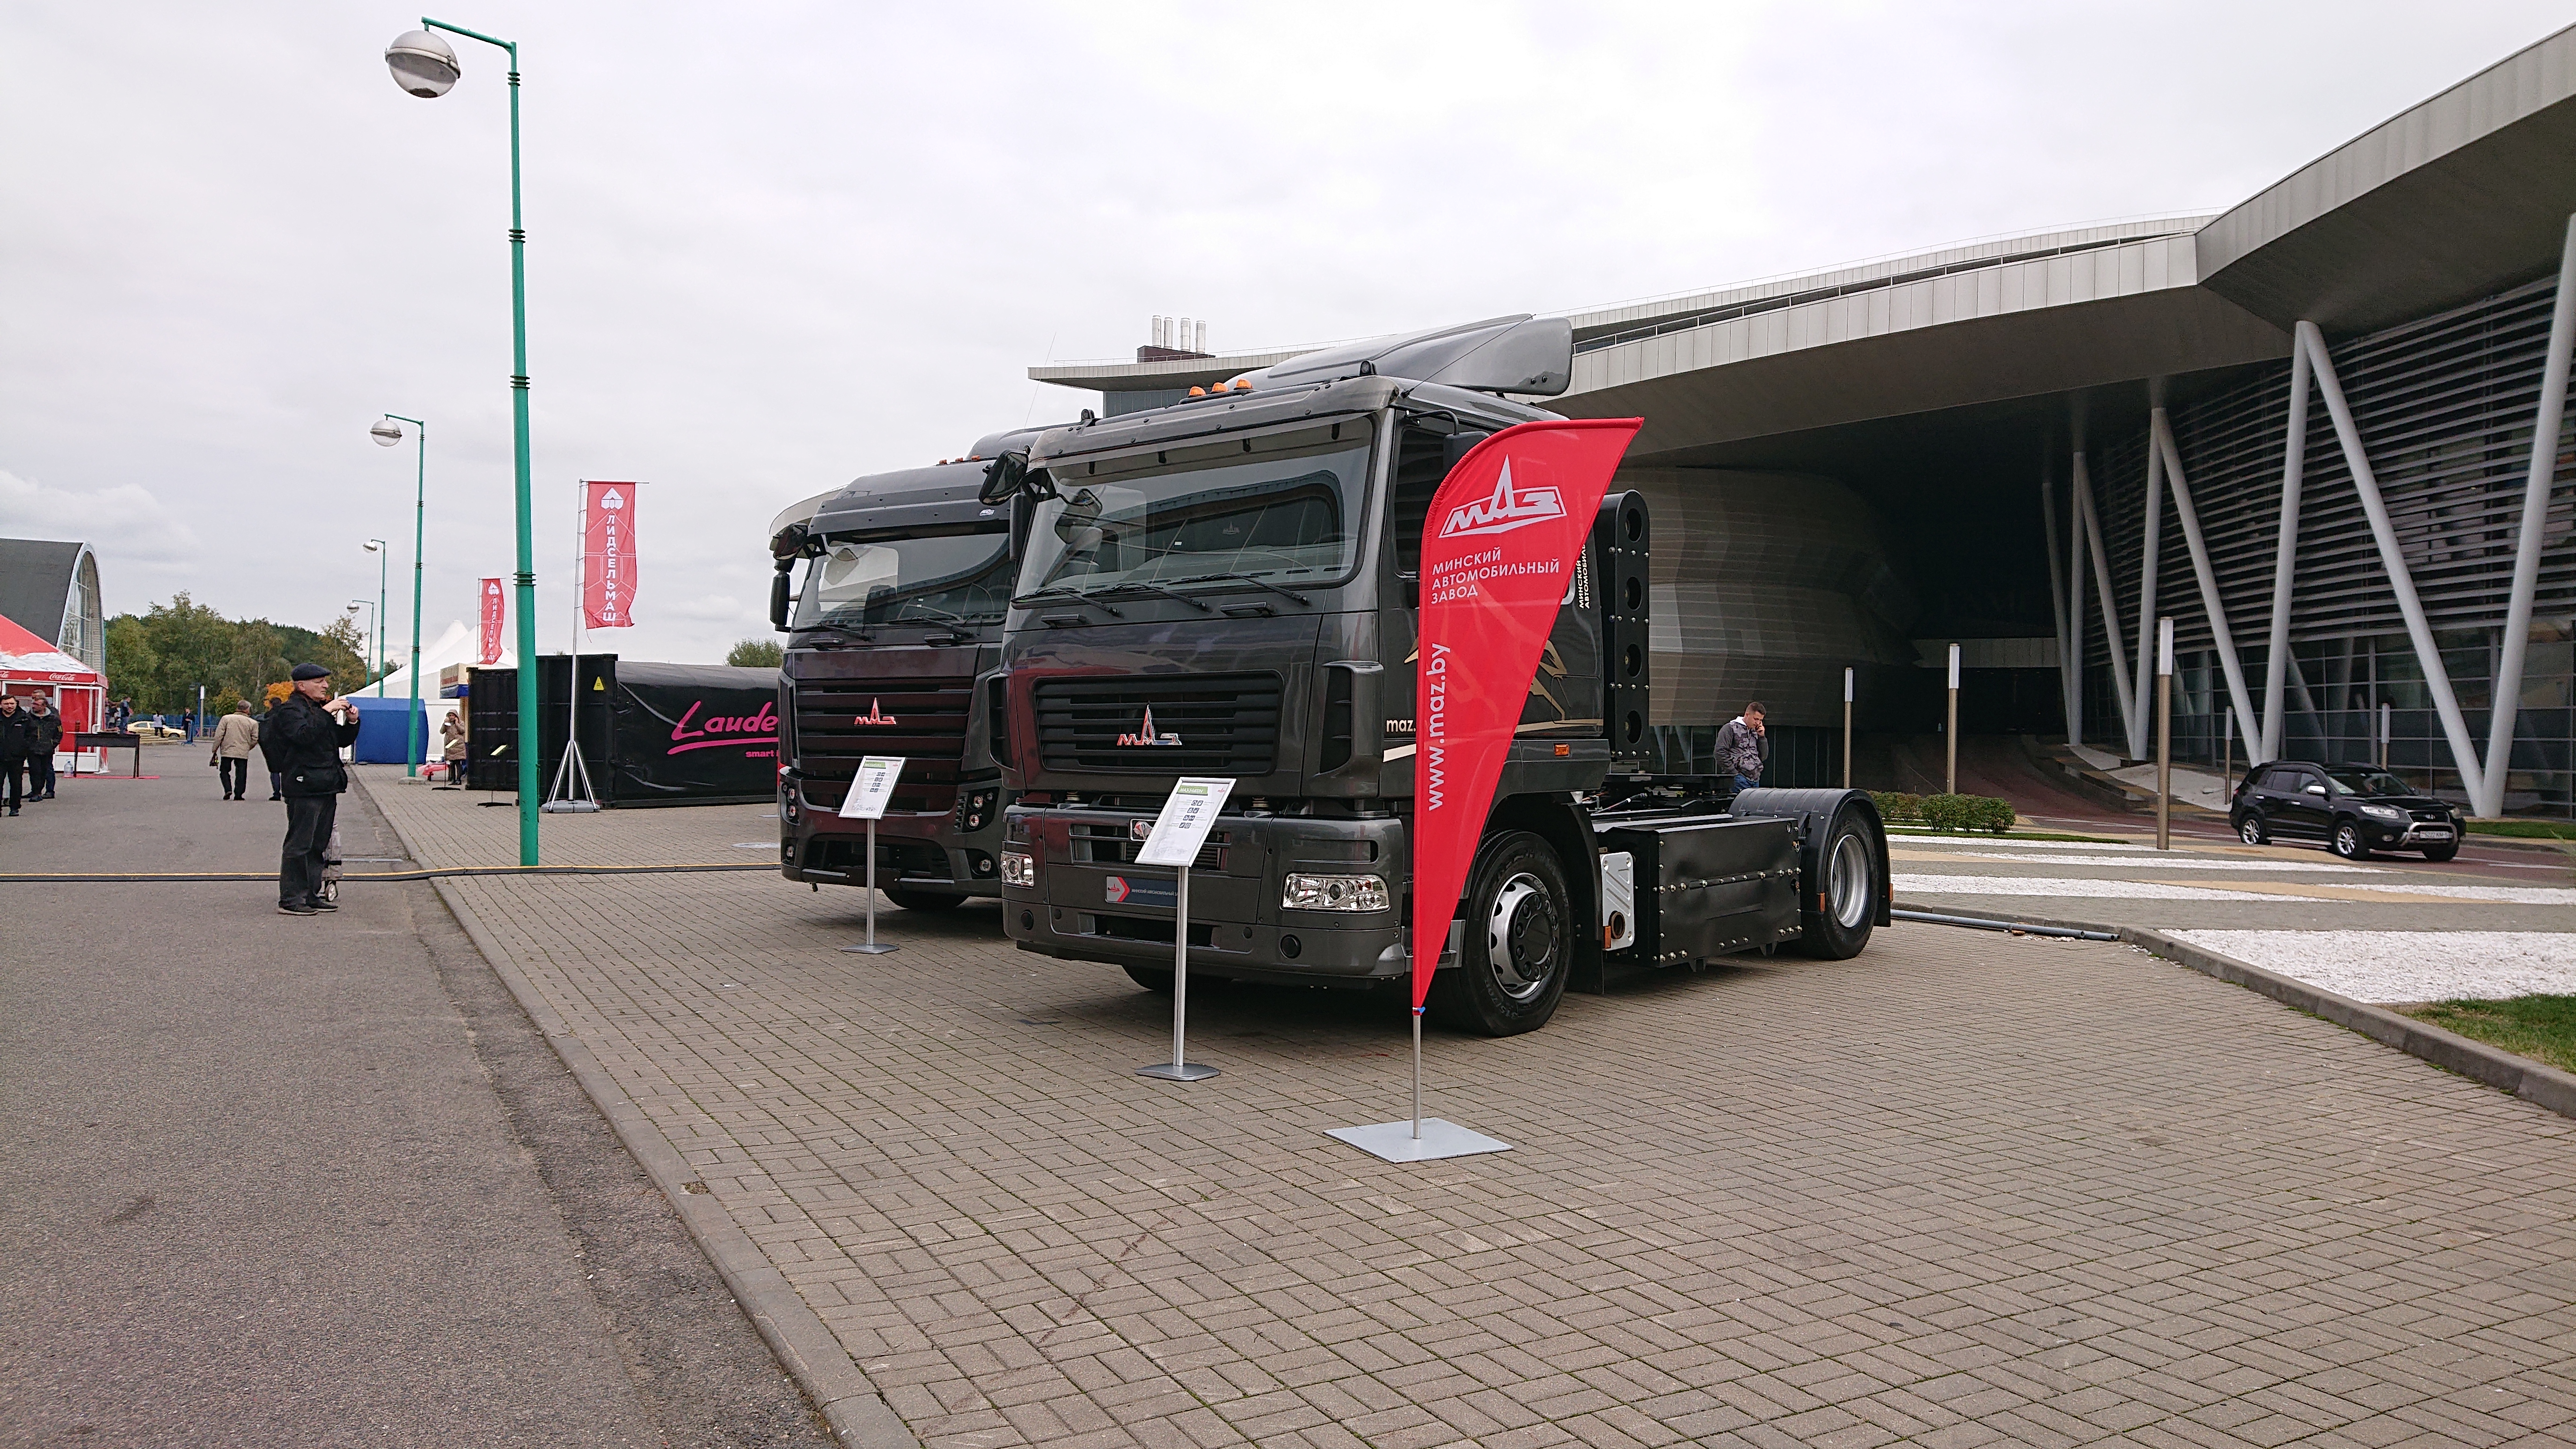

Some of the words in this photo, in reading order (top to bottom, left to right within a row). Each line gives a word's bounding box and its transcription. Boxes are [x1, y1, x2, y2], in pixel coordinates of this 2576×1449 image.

[602, 514, 616, 621] ЛИДСЕЛЬМАШ
[1431, 558, 1559, 591] АВТОМОБИЛЬНЫЙ
[1432, 546, 1501, 575] МИНСКИЙ
[1430, 584, 1478, 605] ЗАВОД
[1575, 560, 1584, 609] МИНСКИЙ
[671, 700, 779, 740] Laude
[854, 697, 897, 725] МАЗ
[1117, 704, 1183, 746] МАЗ
[1426, 643, 1450, 811] www.maz.by
